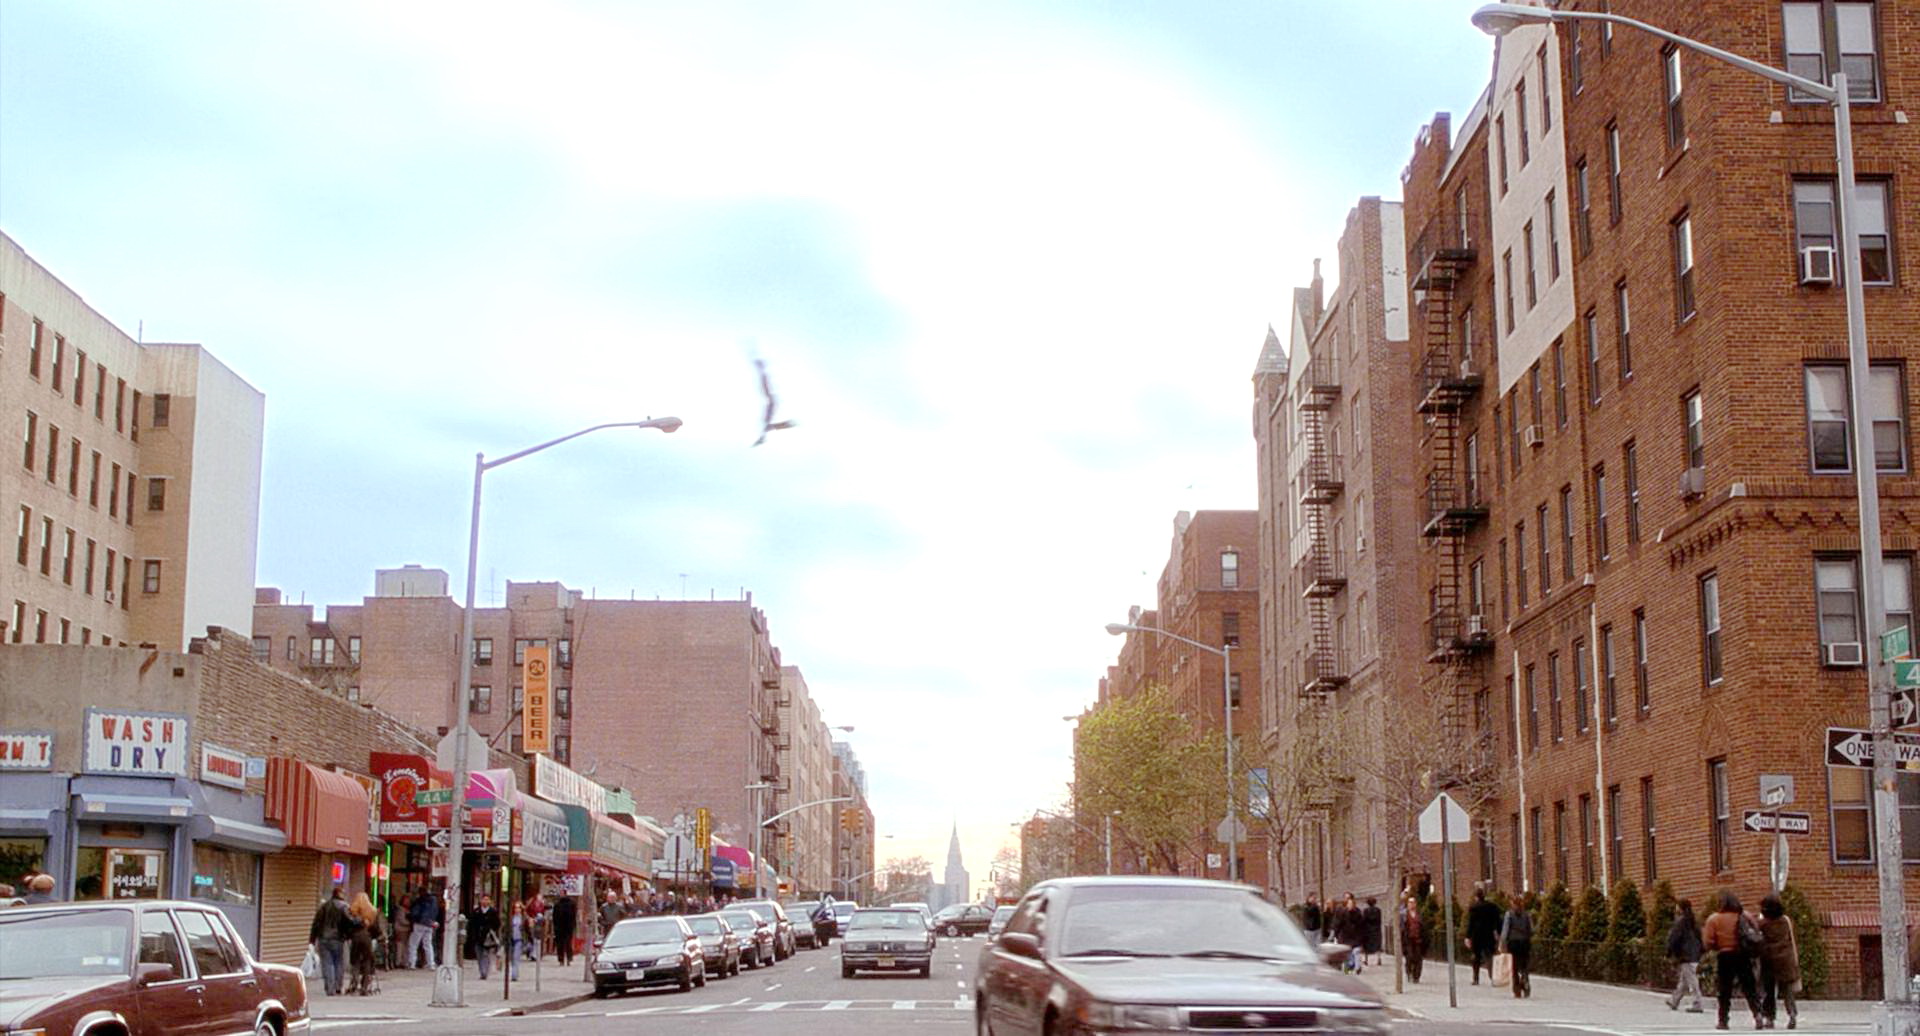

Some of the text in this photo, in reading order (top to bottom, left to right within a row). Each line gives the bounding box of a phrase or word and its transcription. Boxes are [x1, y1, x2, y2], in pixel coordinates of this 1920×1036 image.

[530, 695, 544, 740] BEER
[102, 717, 174, 743] WASH
[111, 745, 167, 769] DRY
[423, 791, 441, 804] 44
[532, 819, 568, 852] CLEANERS
[1785, 820, 1805, 828] WAY
[464, 836, 481, 844] WAY
